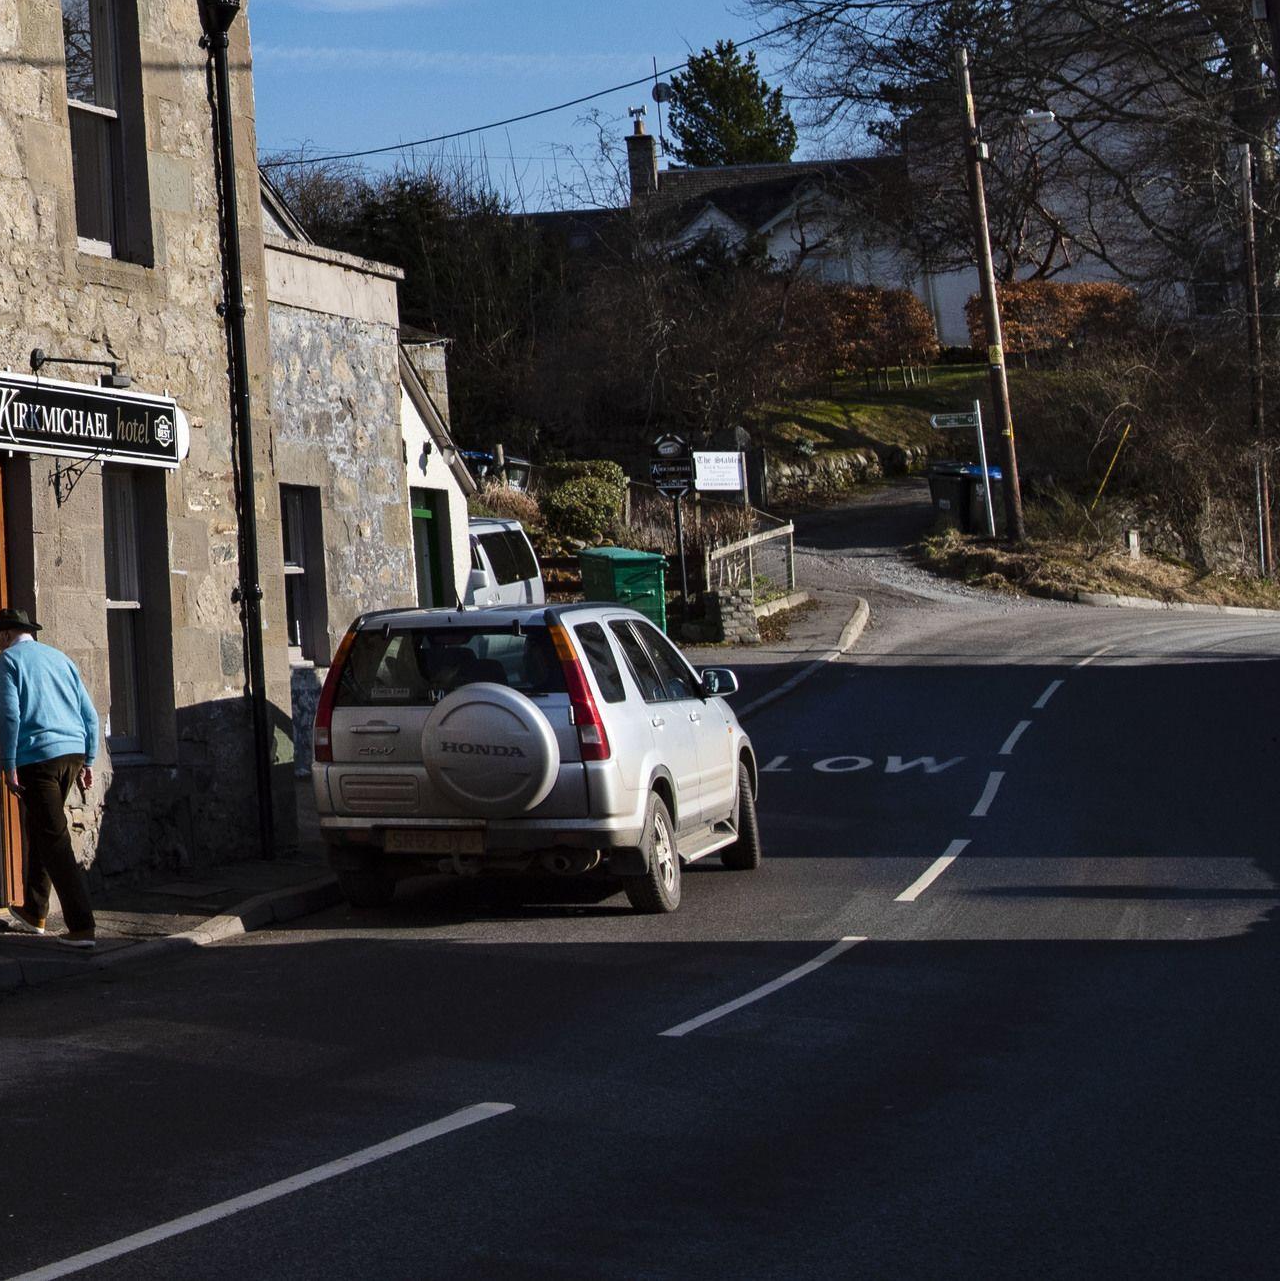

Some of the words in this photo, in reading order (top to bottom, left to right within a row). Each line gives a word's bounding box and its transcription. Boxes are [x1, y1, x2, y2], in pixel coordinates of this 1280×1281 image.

[116, 406, 151, 445] hotel
[441, 741, 527, 758] HONDA
[759, 755, 969, 774] LOW
